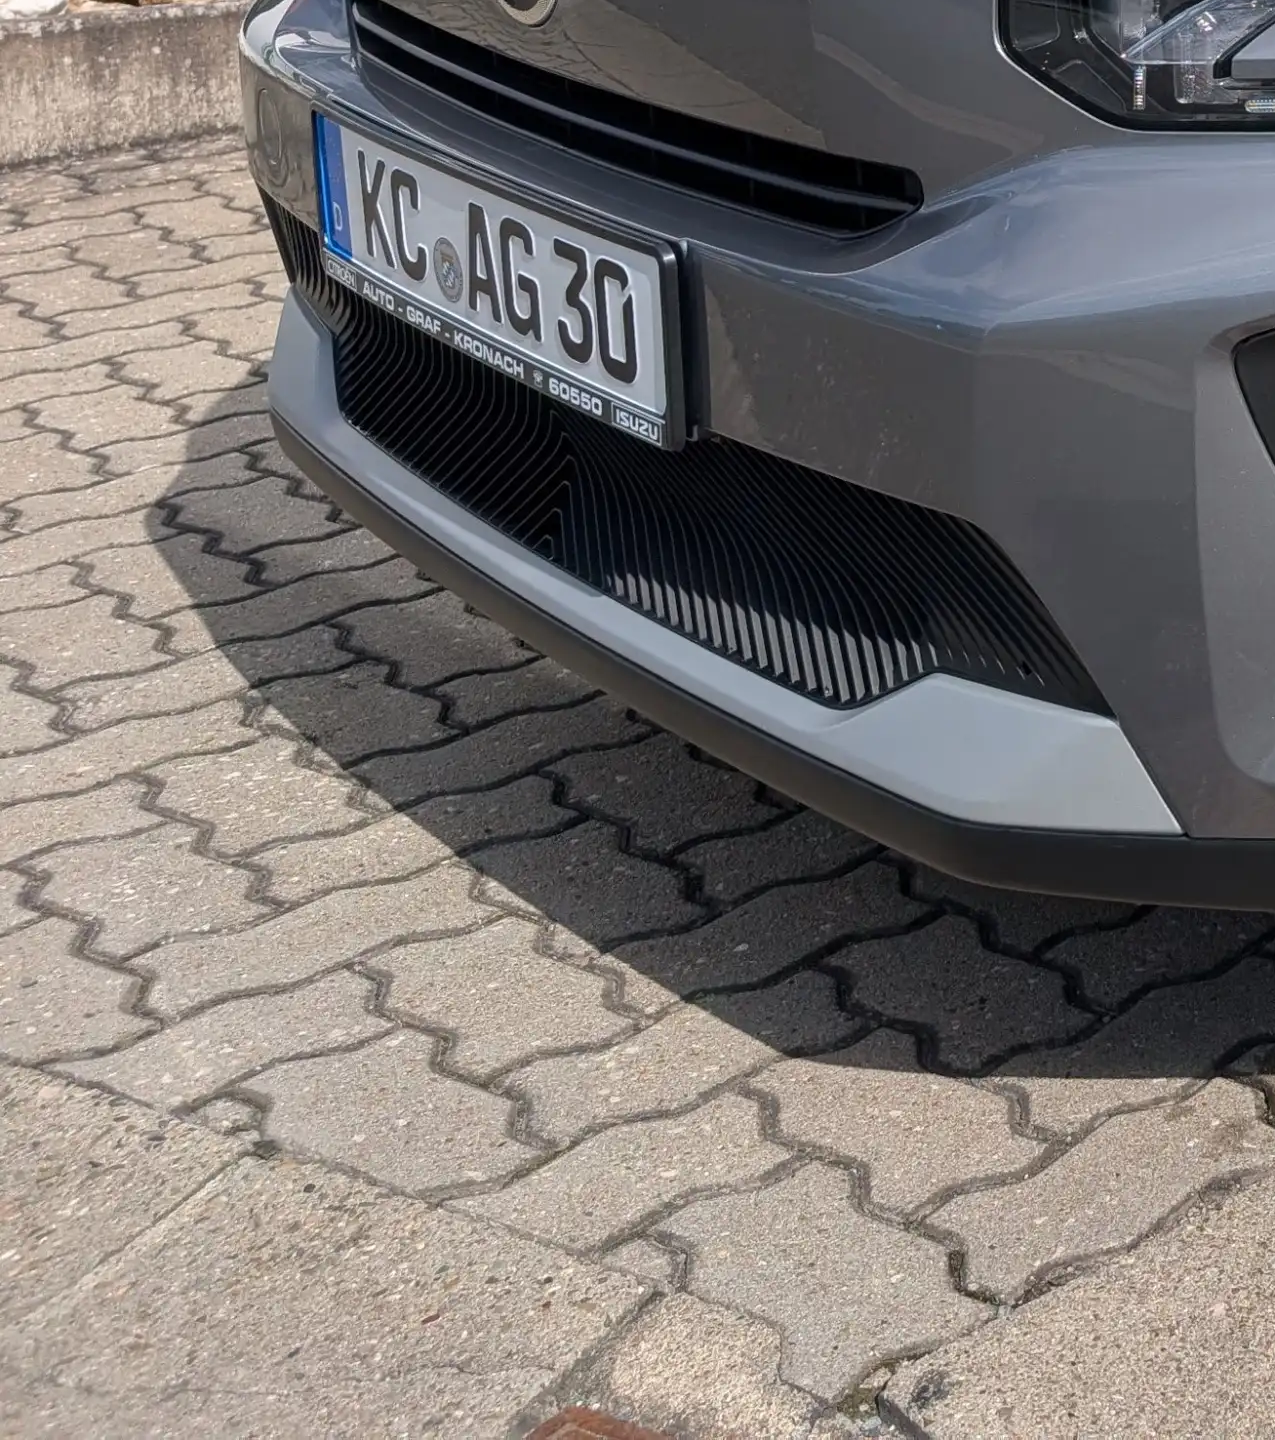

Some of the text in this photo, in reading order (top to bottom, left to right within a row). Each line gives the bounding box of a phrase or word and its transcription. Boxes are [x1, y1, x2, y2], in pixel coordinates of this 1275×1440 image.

[333, 201, 344, 232] D
[356, 148, 430, 283] KC
[362, 280, 395, 311] AUTO
[406, 305, 442, 335] GRAF
[453, 329, 525, 379] KRONACH
[548, 377, 603, 417] 60550
[615, 408, 658, 441] ISUZU
